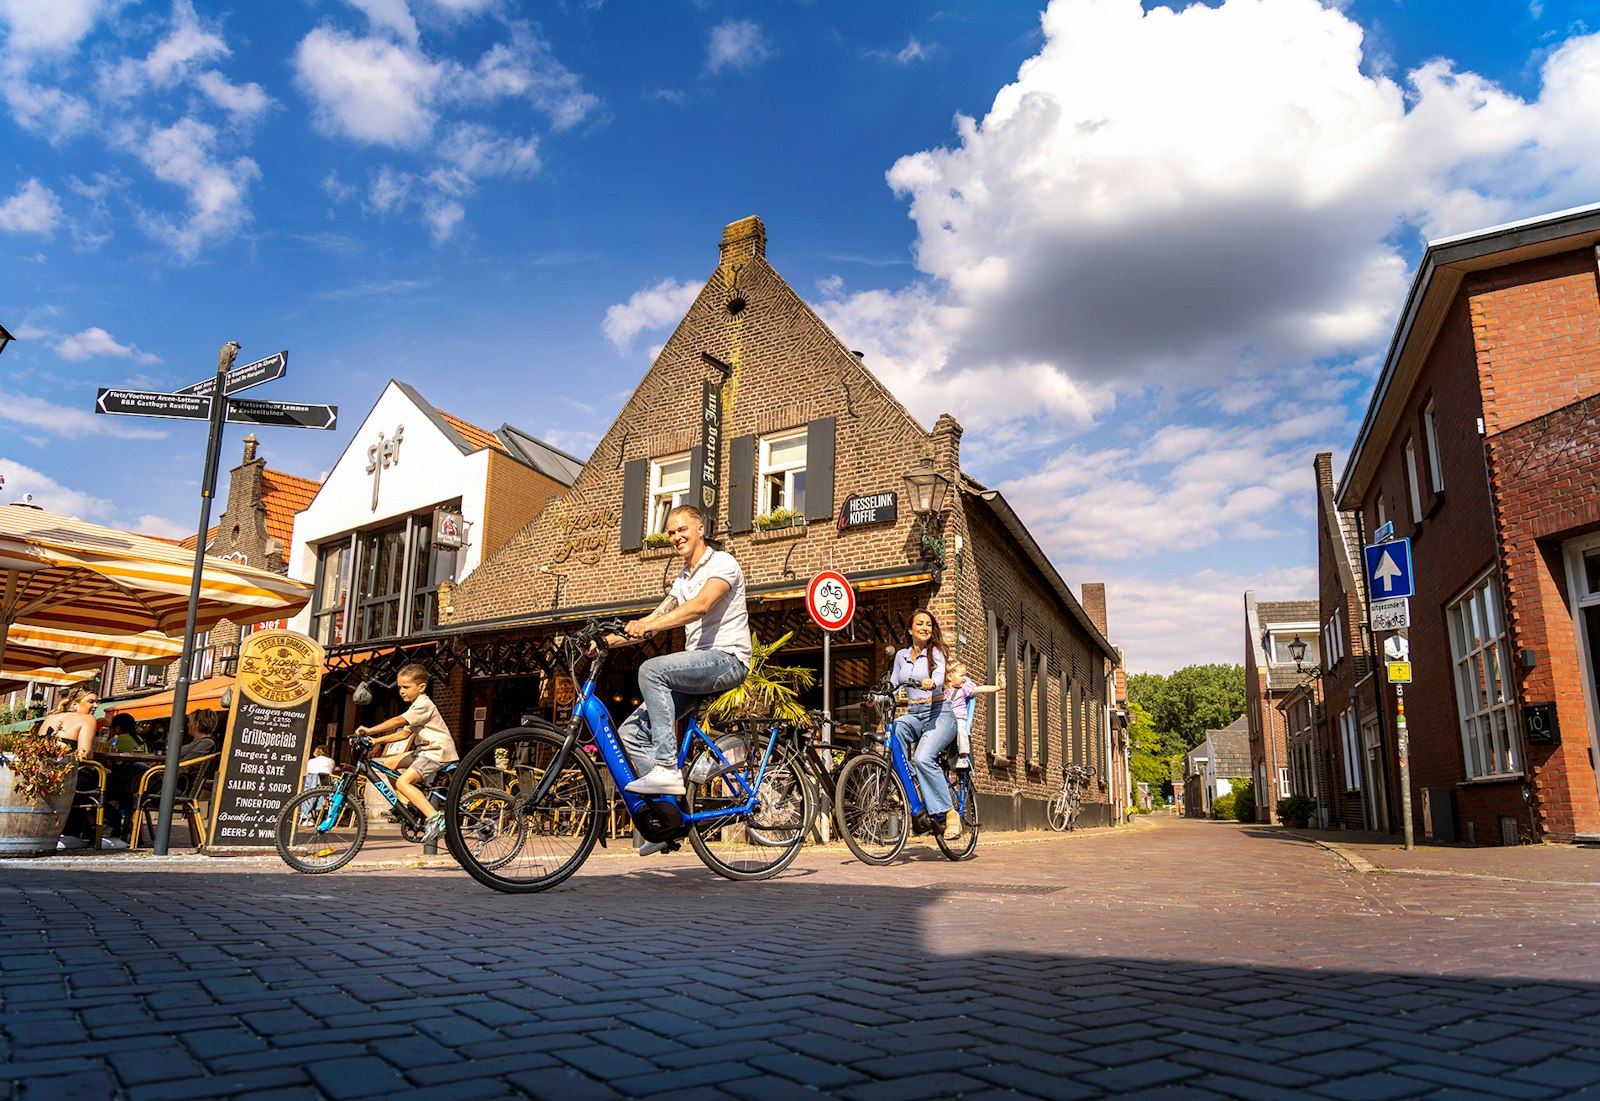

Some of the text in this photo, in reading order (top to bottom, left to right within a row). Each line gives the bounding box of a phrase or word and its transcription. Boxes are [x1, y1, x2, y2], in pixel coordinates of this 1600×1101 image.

[110, 391, 200, 404] Fiets/Voetveer Arcen-Lottum
[137, 400, 167, 409] Gasthuys
[169, 402, 200, 411] Rustique
[282, 404, 309, 412] Lemmen
[705, 393, 720, 427] Jan
[703, 424, 718, 485] Hertog
[850, 493, 893, 511] HESSELINK
[850, 509, 876, 525] KOFFIE
[1371, 600, 1406, 612] uitgezonderd
[276, 637, 285, 646] EN
[240, 704, 247, 712] 3
[1527, 715, 1543, 731] 10
[241, 727, 297, 749] Grillspecials
[234, 748, 298, 762] Burgers & ribs
[240, 762, 286, 776] FISH & SATÉ
[227, 780, 292, 794] SALADS & SOUPS
[218, 811, 258, 823] Breakfast
[221, 827, 248, 837] BEERS
[247, 828, 255, 838] &
